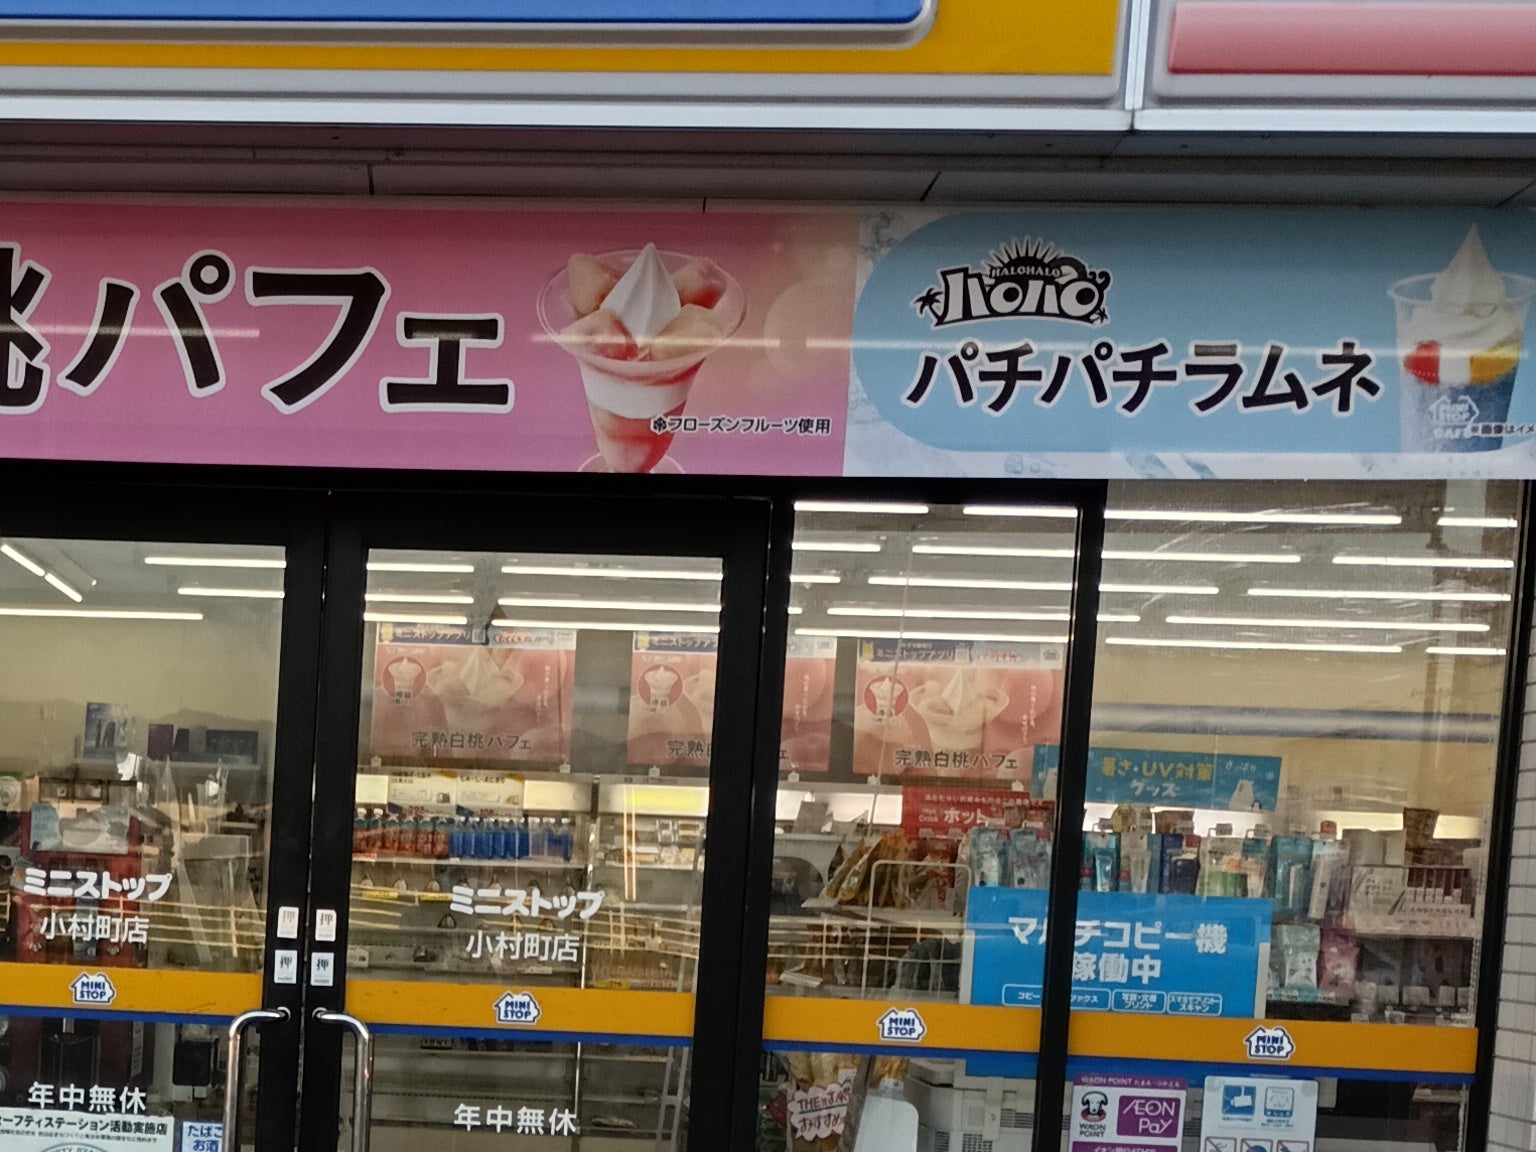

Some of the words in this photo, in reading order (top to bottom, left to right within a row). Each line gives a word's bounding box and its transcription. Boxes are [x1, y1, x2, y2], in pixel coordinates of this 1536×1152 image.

[992, 265, 1061, 277] HALOHALO
[906, 341, 1380, 412] パチパチラムネ
[411, 731, 533, 751] 完熟白桃パフェ
[894, 749, 1019, 770] 完熟白桃パフェ
[23, 868, 173, 900] ミニストップ
[449, 885, 605, 920] ミニストップ
[39, 914, 150, 944] 小村町店
[465, 931, 580, 962] 小村町店
[80, 981, 106, 991] MINI
[79, 990, 107, 1000] STOP
[504, 999, 531, 1010] MINI
[503, 1009, 532, 1020] STOP
[888, 1017, 915, 1026] MINI
[887, 1025, 917, 1036] STOP
[1256, 1034, 1284, 1045] MINI
[1254, 1044, 1285, 1055] STOP
[28, 1080, 147, 1115] 年中無休
[453, 1103, 578, 1136] 年中無休
[1138, 1117, 1173, 1134] Pay
